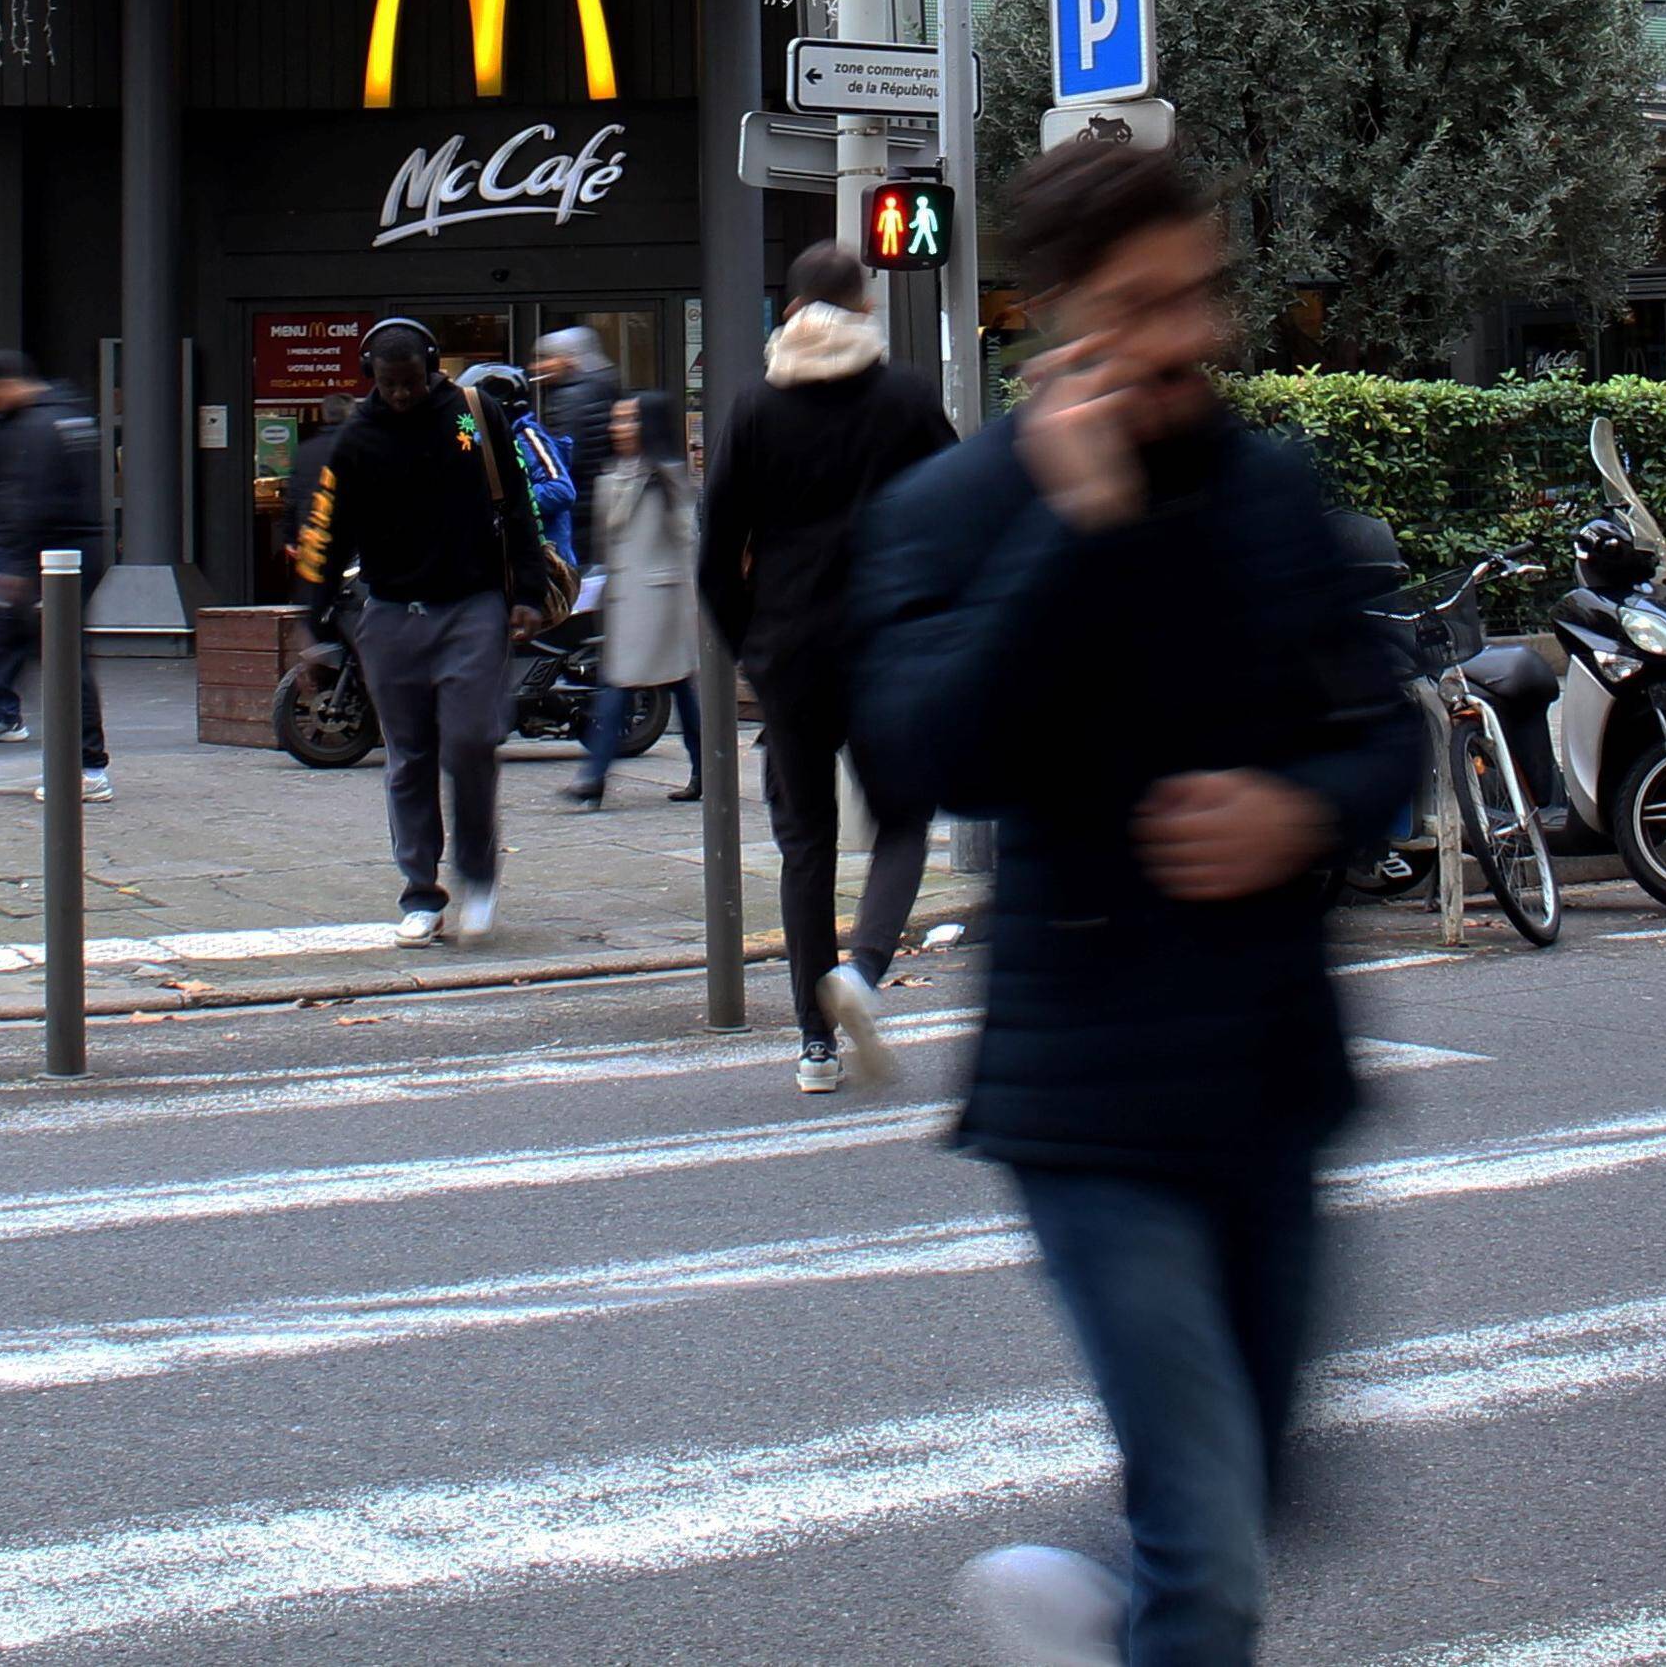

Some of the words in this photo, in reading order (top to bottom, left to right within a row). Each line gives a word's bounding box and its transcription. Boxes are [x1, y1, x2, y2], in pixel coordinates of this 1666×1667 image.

[834, 62, 863, 75] zone
[847, 82, 863, 94] de
[865, 82, 877, 94] la
[376, 123, 627, 238] McCafé
[270, 325, 307, 338] MENU
[328, 321, 359, 337] CINÉ
